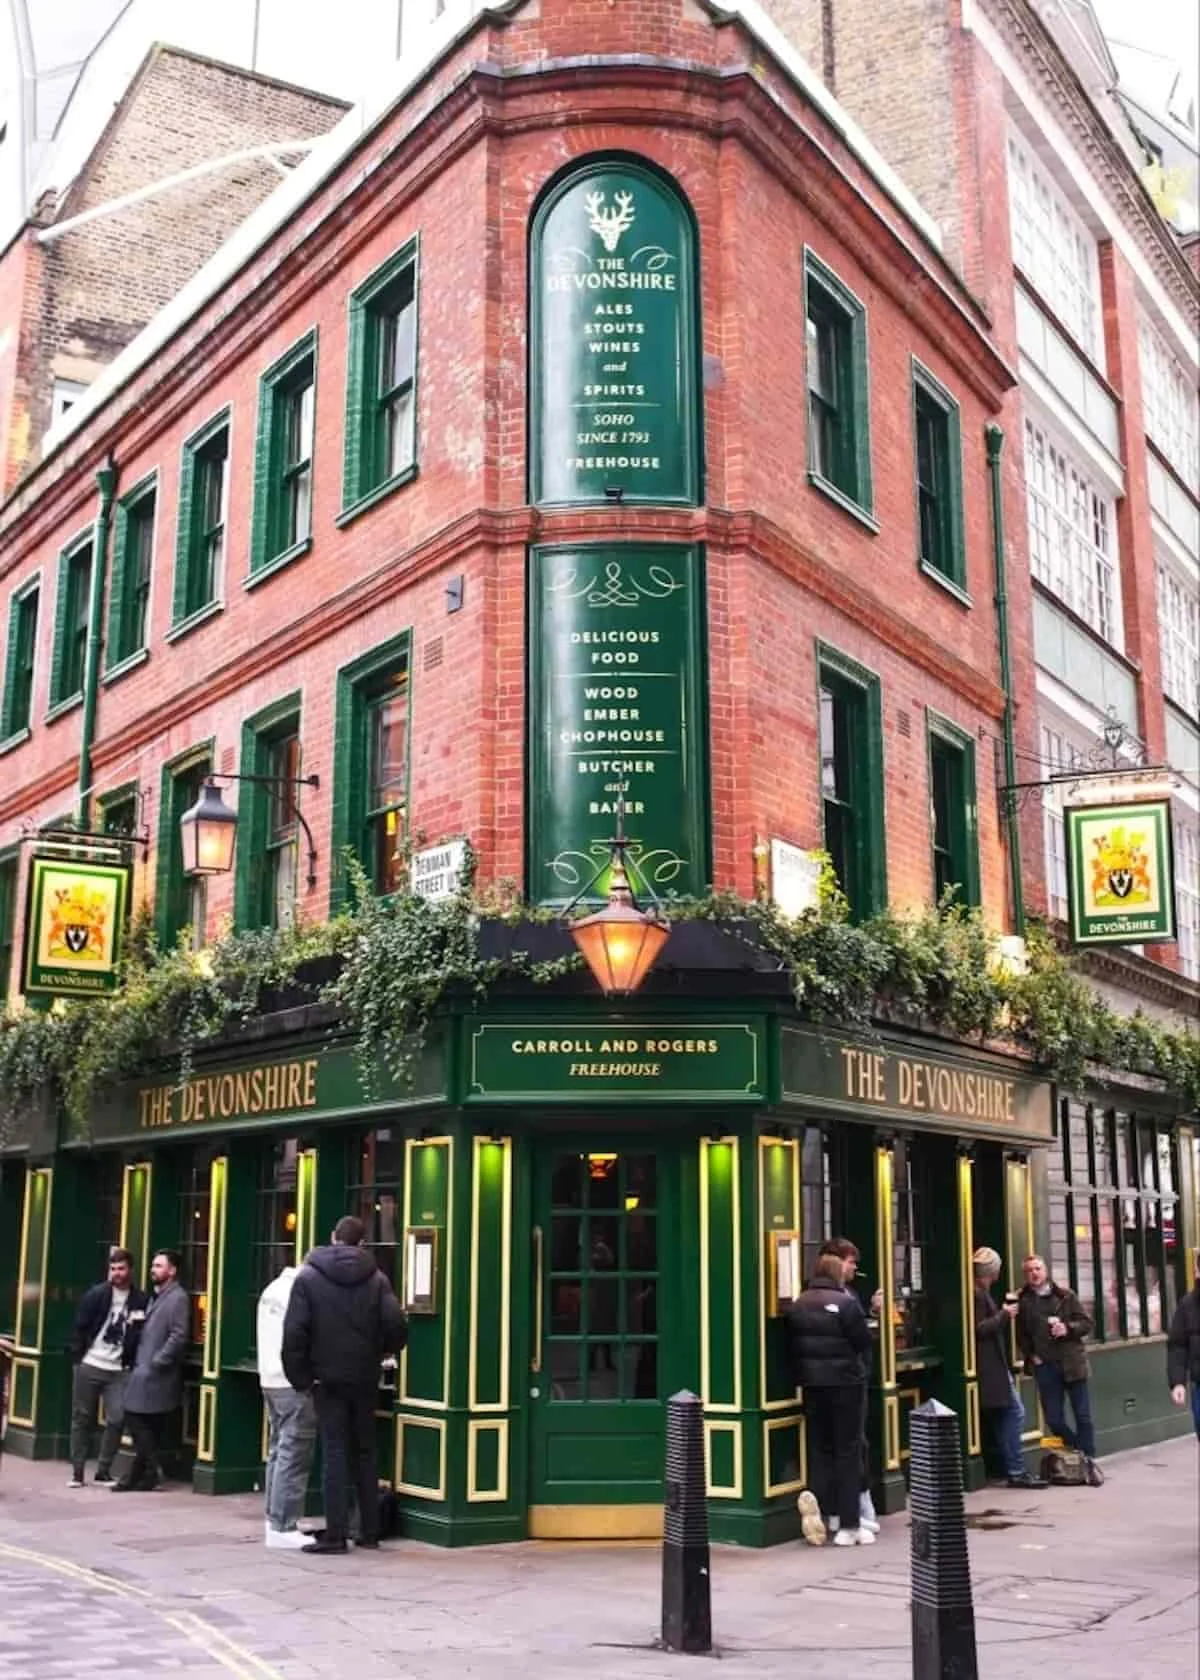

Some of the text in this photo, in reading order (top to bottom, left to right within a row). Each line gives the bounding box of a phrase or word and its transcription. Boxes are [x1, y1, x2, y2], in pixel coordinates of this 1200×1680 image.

[597, 258, 624, 270] THE
[547, 273, 676, 290] DEVONSHIRE
[595, 304, 633, 315] ALES
[584, 323, 645, 334] STOUTS
[589, 342, 640, 353] WINES
[602, 360, 627, 373] and
[584, 384, 645, 397] SPIRITS
[592, 413, 634, 426] SOHO
[576, 431, 617, 444] SINCE
[566, 456, 660, 469] FREEHOUSE
[570, 630, 660, 643] DELICIOUS
[591, 651, 639, 664] FOOD
[584, 687, 639, 700] WOOD
[584, 708, 640, 721] EMBER
[560, 729, 664, 743] CHOPHOUSE
[578, 760, 655, 773] BUTCHER
[415, 873, 444, 897] STREET
[1089, 920, 1157, 934] DEVONSHIRE
[511, 1040, 718, 1053] CARROLL AND ROGERS
[569, 1063, 661, 1076] FREEHOUSE
[841, 1048, 1015, 1121] THE DEVONSHIRE
[139, 1059, 319, 1127] THE DEVONSHIRE
